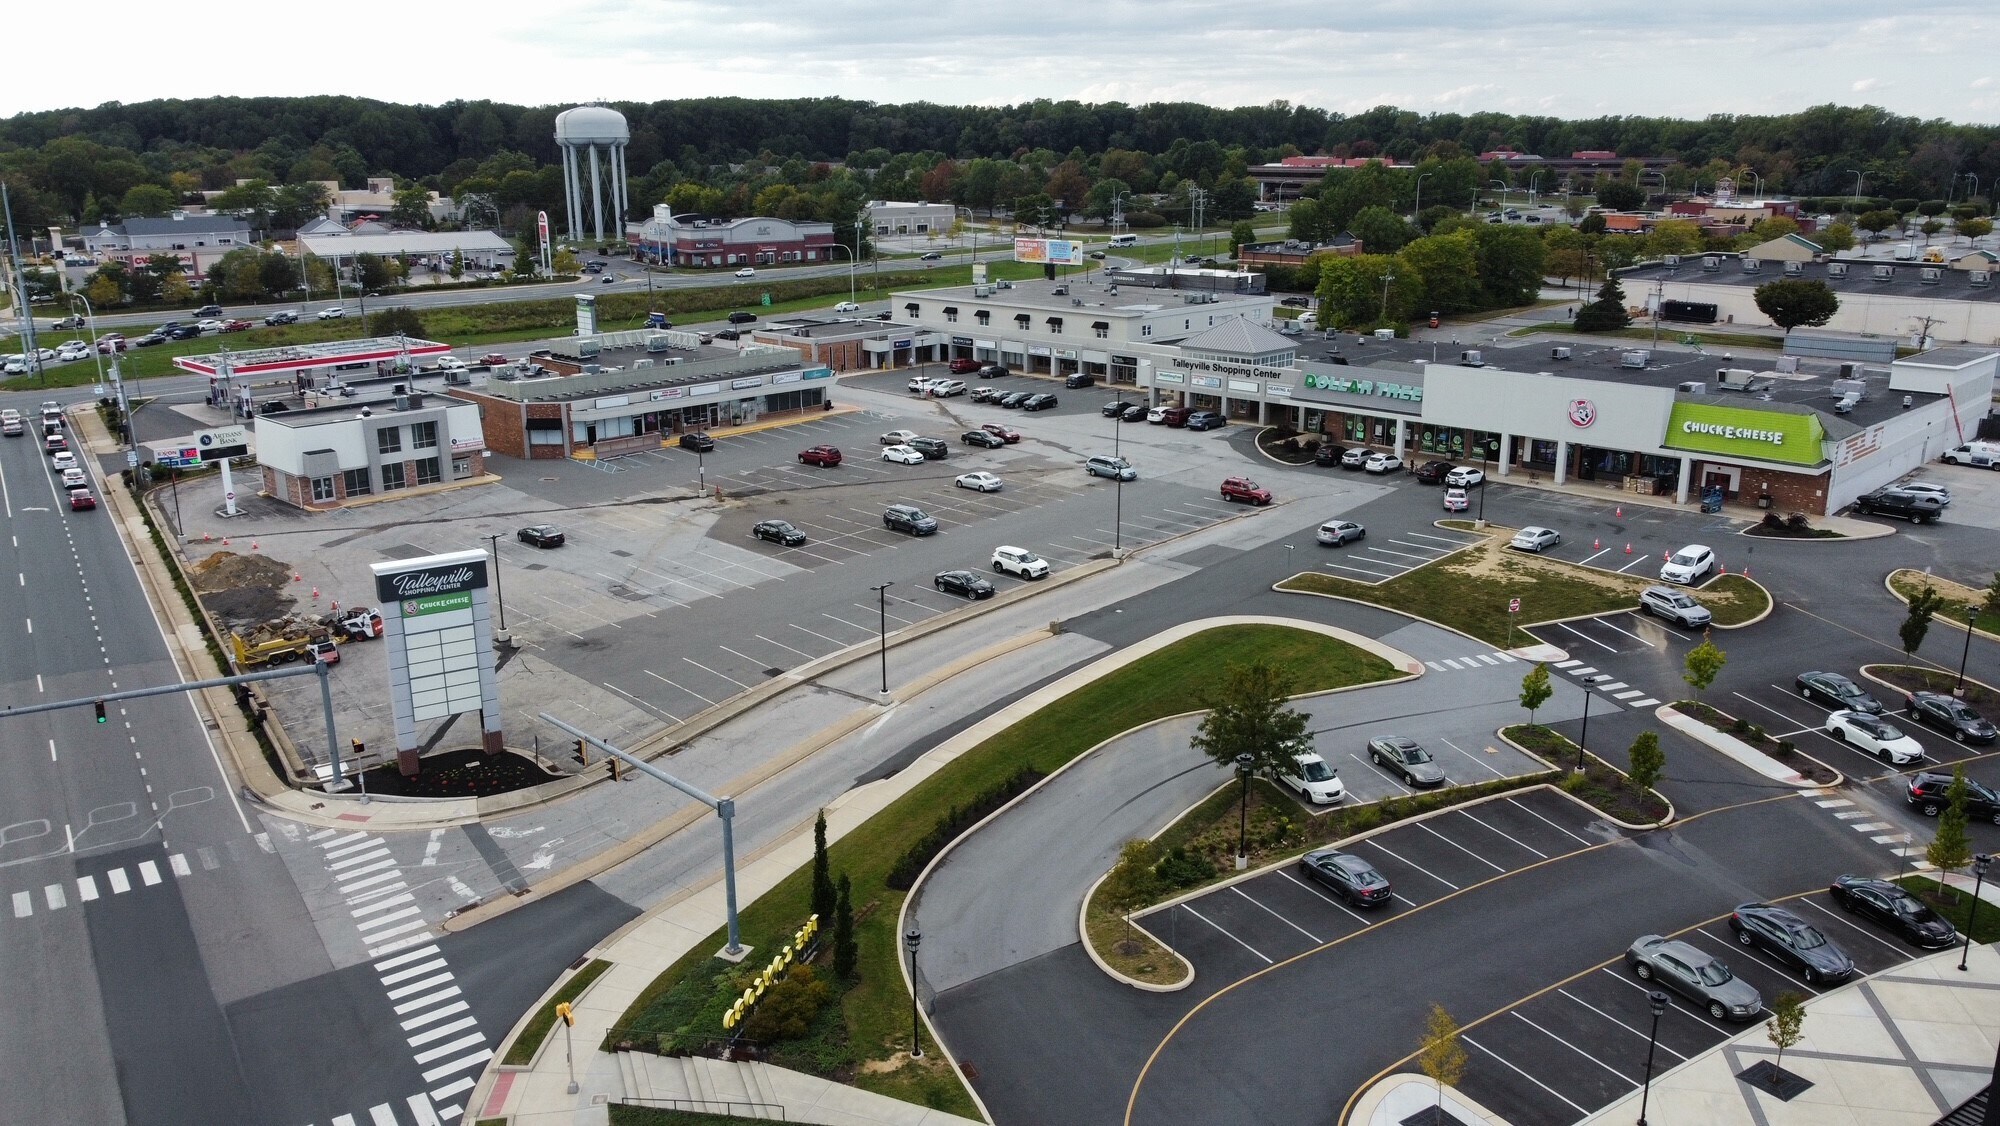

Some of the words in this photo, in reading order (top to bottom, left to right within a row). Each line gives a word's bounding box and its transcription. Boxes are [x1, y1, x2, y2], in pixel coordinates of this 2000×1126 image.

[1172, 359, 1210, 371] Talleyville
[1212, 363, 1251, 378] Shopping
[1253, 368, 1282, 379] Center
[1304, 374, 1373, 396] DOLLAR
[1376, 381, 1423, 402] TREE
[1683, 421, 1724, 435] CHUCK
[1736, 428, 1783, 445] CHEESE
[393, 567, 474, 594] Talleyville
[404, 587, 435, 596] SHOPPING
[440, 582, 461, 591] CENTER
[420, 601, 441, 610] CHUCK
[446, 597, 469, 606] CHEESE
